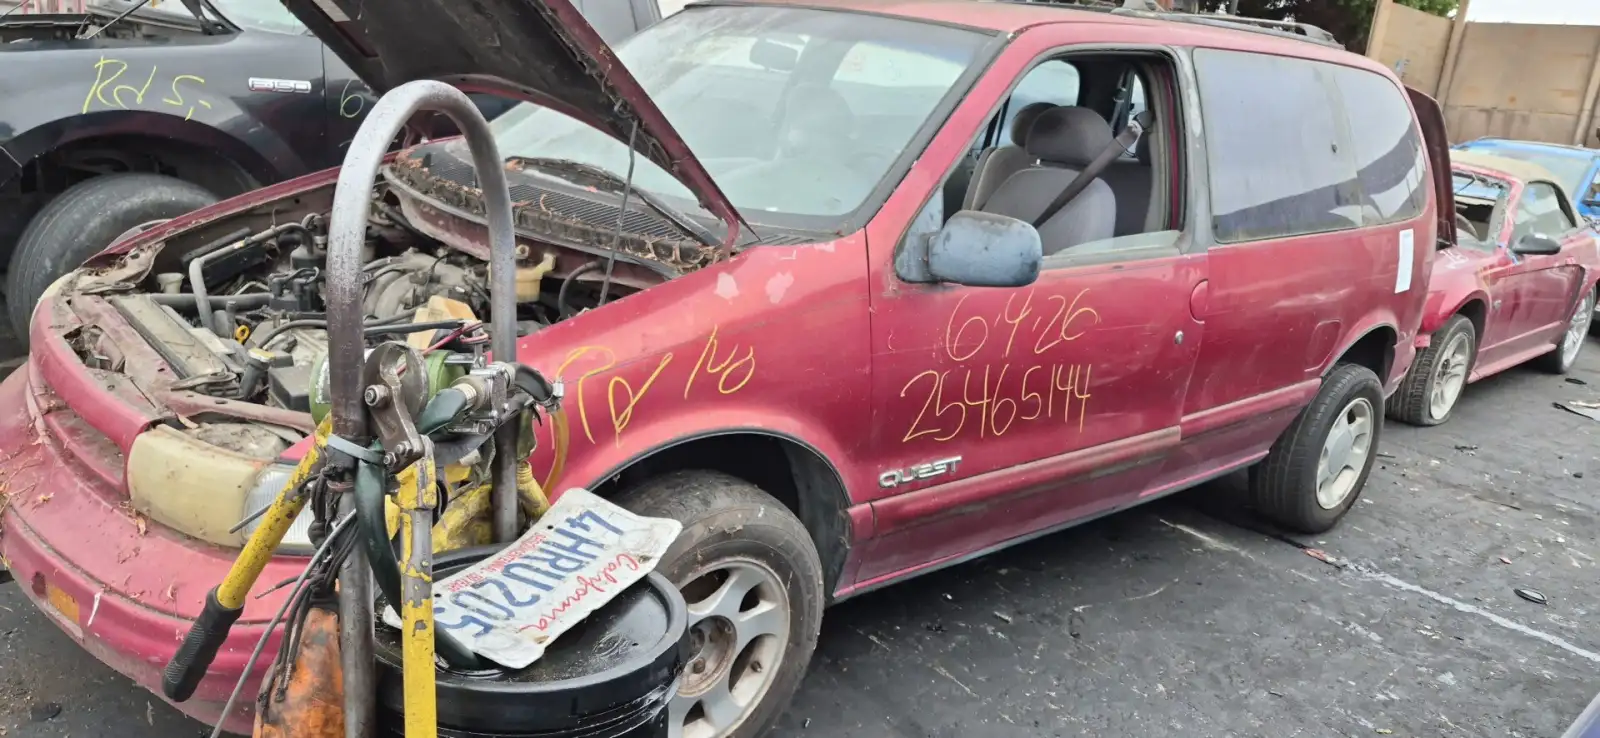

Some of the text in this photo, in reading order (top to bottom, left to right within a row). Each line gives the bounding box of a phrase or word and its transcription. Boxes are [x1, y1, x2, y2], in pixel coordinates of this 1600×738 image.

[900, 363, 1092, 442] 25465144
[878, 455, 963, 488] QUEST
[433, 510, 624, 639] 4HRU205
[519, 553, 639, 631] California
